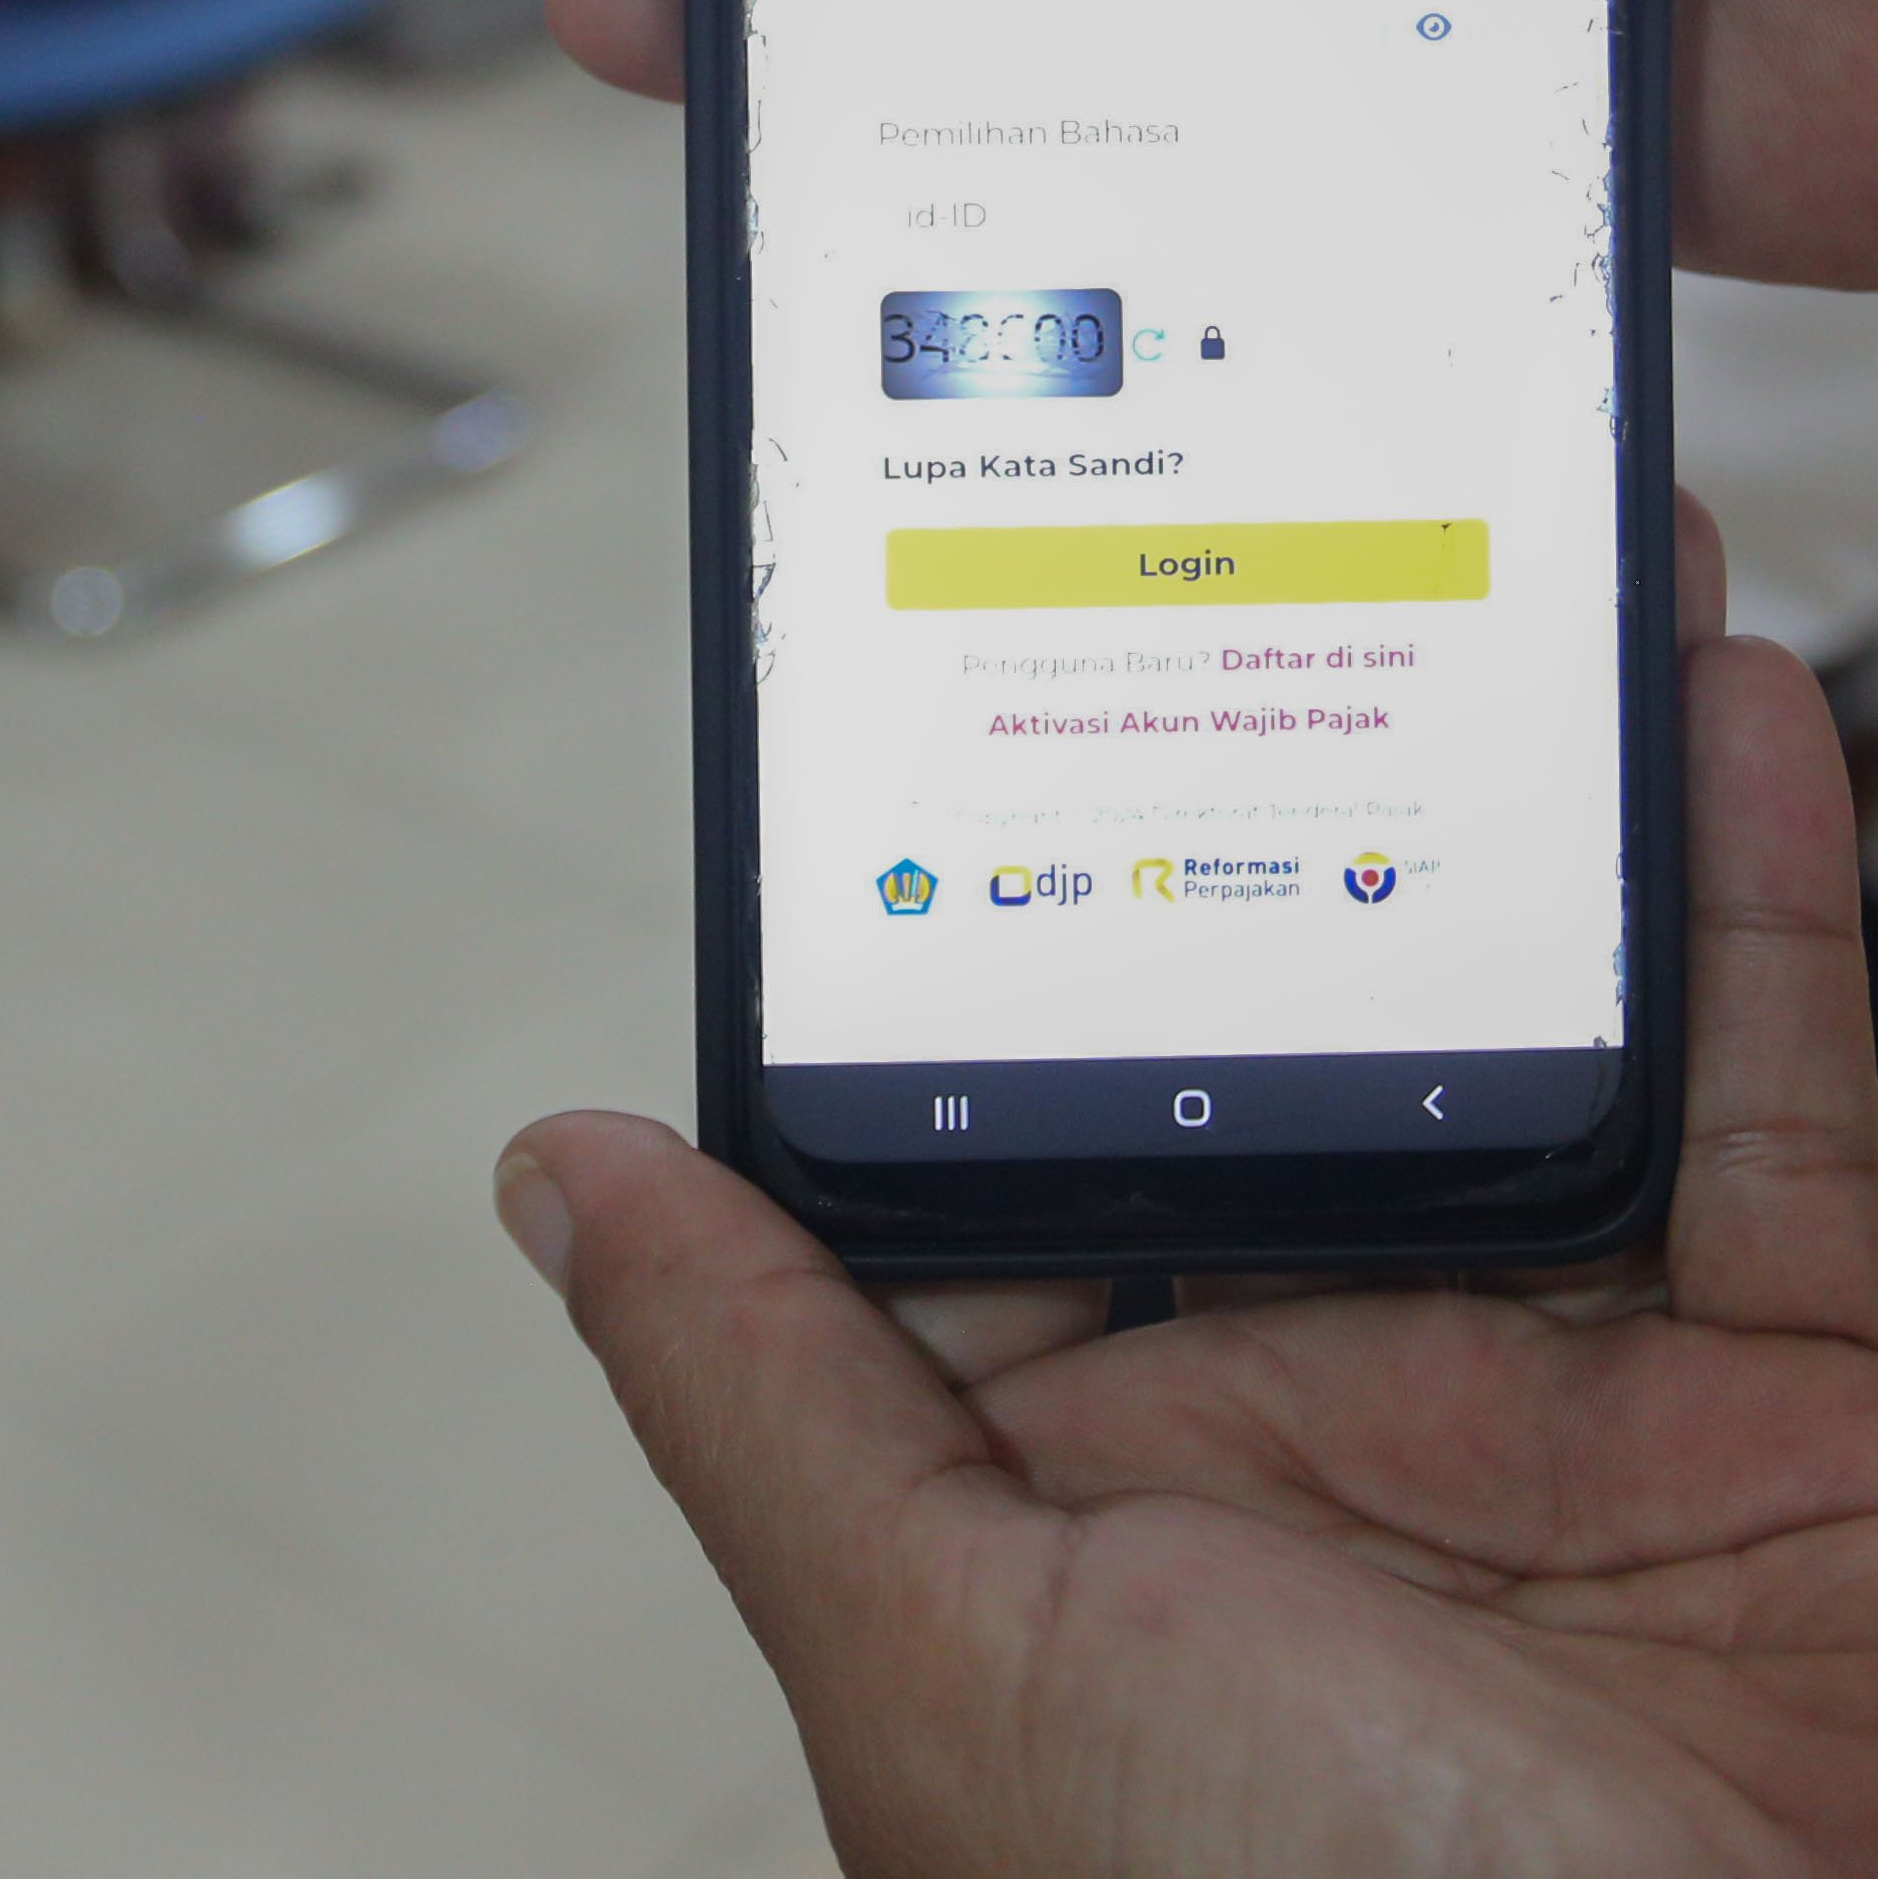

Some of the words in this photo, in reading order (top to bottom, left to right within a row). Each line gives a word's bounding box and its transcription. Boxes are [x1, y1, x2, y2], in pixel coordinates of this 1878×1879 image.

[879, 121, 1047, 147] Pemilihan
[1060, 119, 1179, 145] Bahasa
[908, 203, 987, 228] id-ID
[884, 456, 967, 485] Lupa
[980, 455, 1056, 478] Kata
[1068, 450, 1184, 477] Sandi?
[1139, 549, 1236, 582] Login
[1222, 647, 1316, 671] Daftar
[1326, 645, 1352, 669] di
[1363, 643, 1414, 668] sini
[988, 711, 1109, 736] Aktivasi
[1119, 710, 1199, 734] Akun
[1210, 707, 1297, 737] Wajib
[1307, 706, 1389, 735] Pajak
[1184, 856, 1300, 876] Reformasi
[1036, 863, 1093, 906] djp
[1184, 879, 1300, 902] Perpajakan
